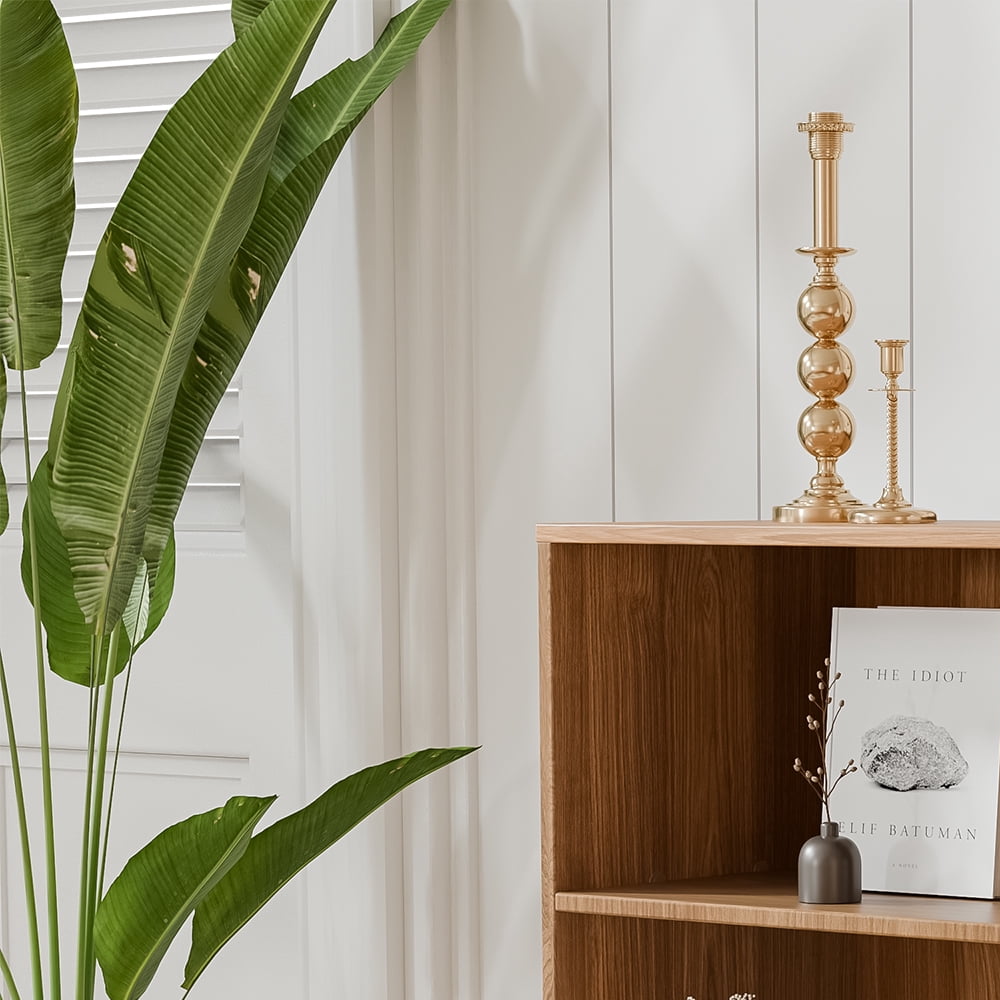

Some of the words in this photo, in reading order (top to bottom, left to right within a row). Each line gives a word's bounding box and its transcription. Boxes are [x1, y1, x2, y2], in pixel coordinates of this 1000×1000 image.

[864, 668, 900, 681] THE
[911, 669, 968, 683] IDIOT
[838, 821, 879, 835] ELIF
[889, 824, 978, 840] BATUMAN
